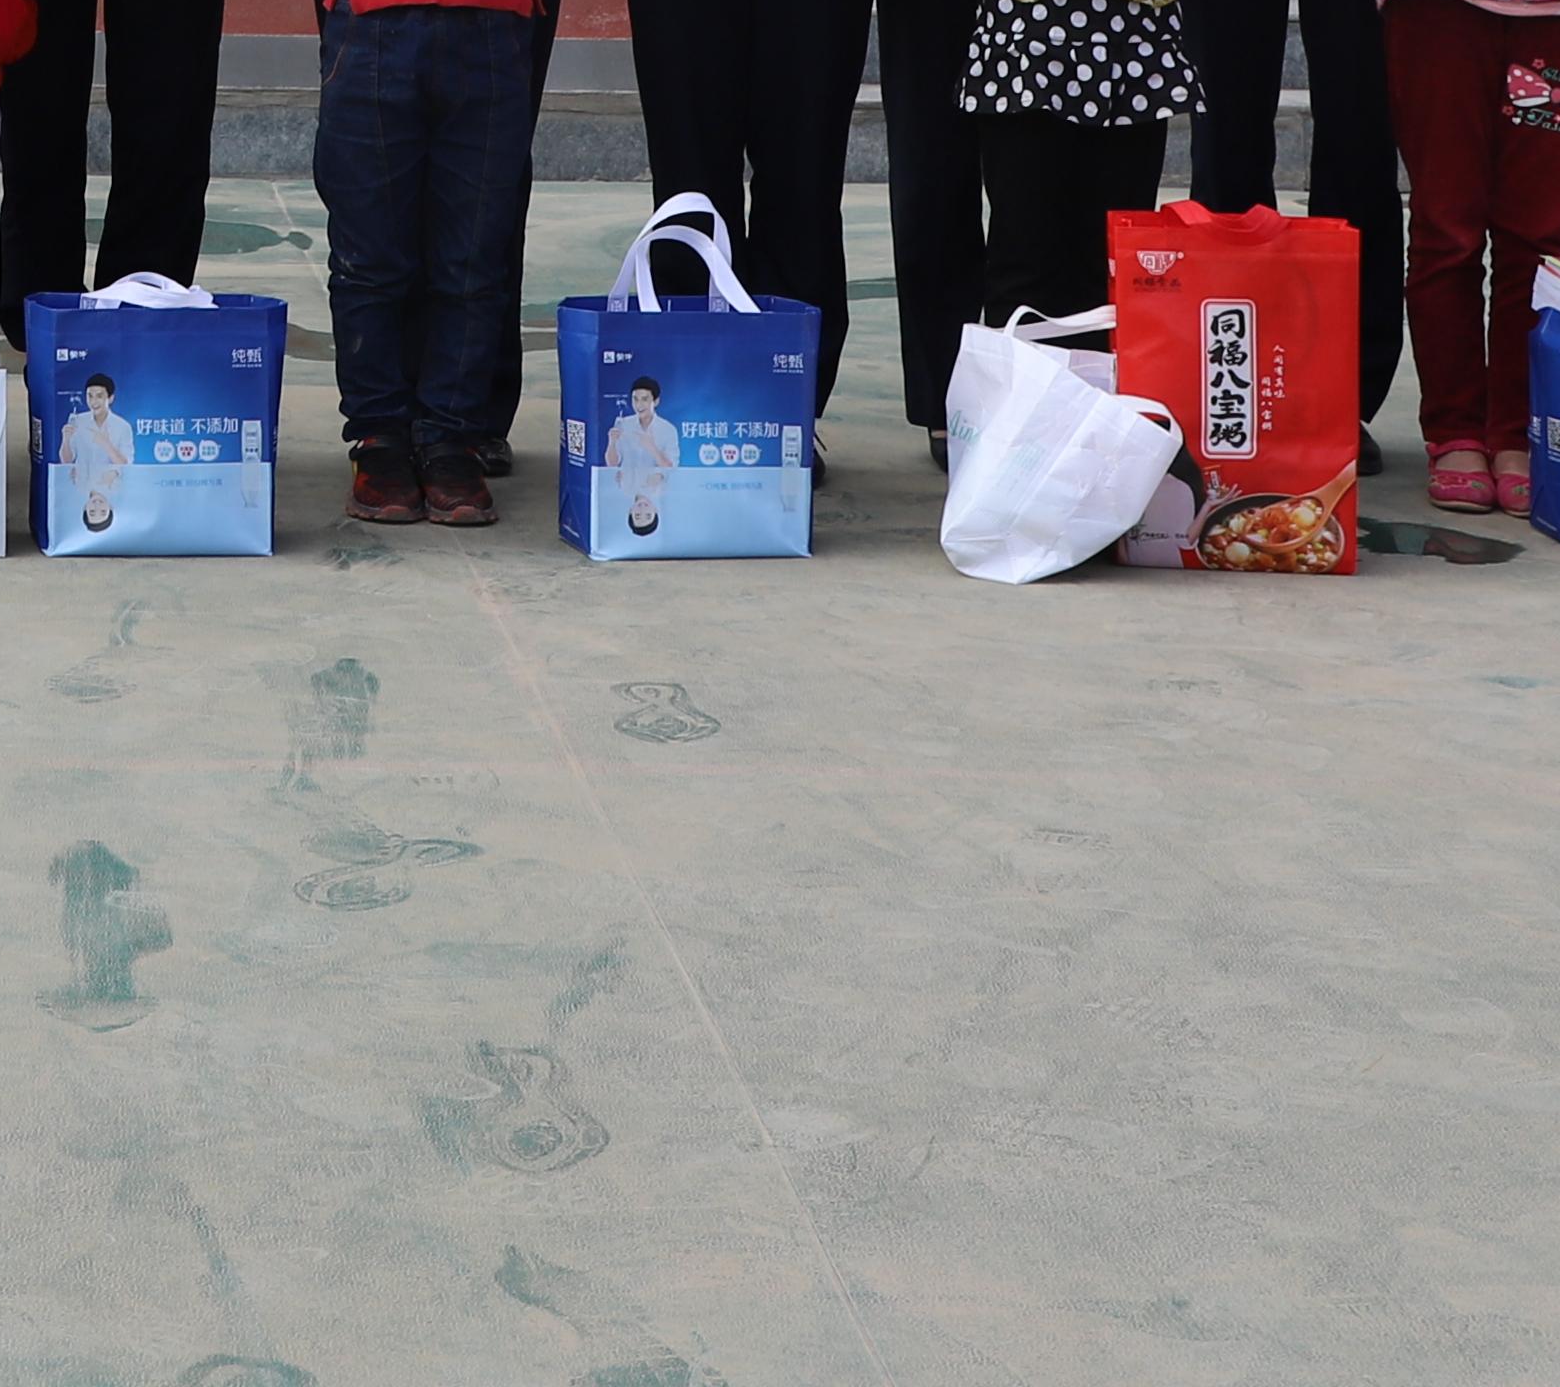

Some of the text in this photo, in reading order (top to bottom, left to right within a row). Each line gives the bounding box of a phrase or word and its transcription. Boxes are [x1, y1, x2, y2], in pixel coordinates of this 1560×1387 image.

[1207, 308, 1251, 450] 同福八宝粥
[136, 418, 239, 436] 好味道 不添加
[681, 420, 779, 438] 好味道 不添加
